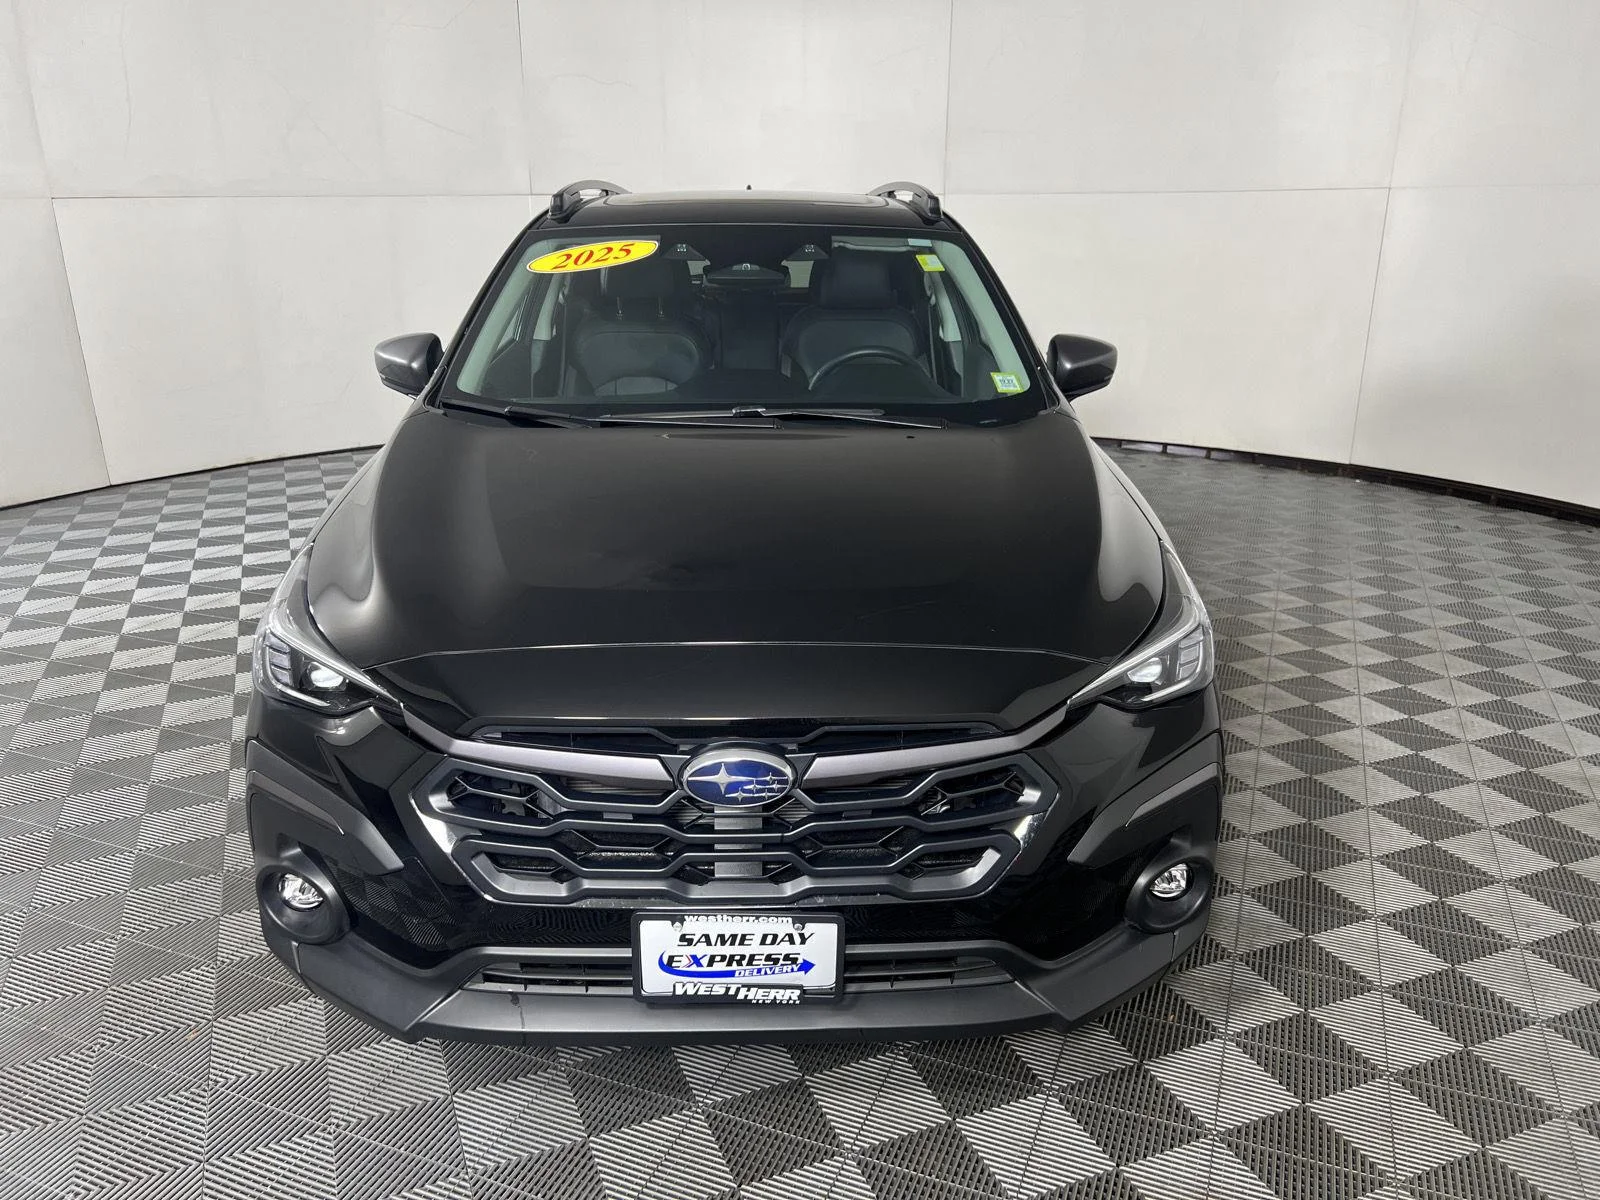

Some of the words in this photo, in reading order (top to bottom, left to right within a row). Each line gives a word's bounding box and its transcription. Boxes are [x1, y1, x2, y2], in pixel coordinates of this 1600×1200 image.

[551, 242, 636, 271] 2025
[684, 915, 793, 924] westherr.com
[677, 933, 756, 947] SAME
[759, 932, 815, 946] DAY
[666, 953, 801, 968] EXPRESS
[734, 964, 801, 977] DELIVERY
